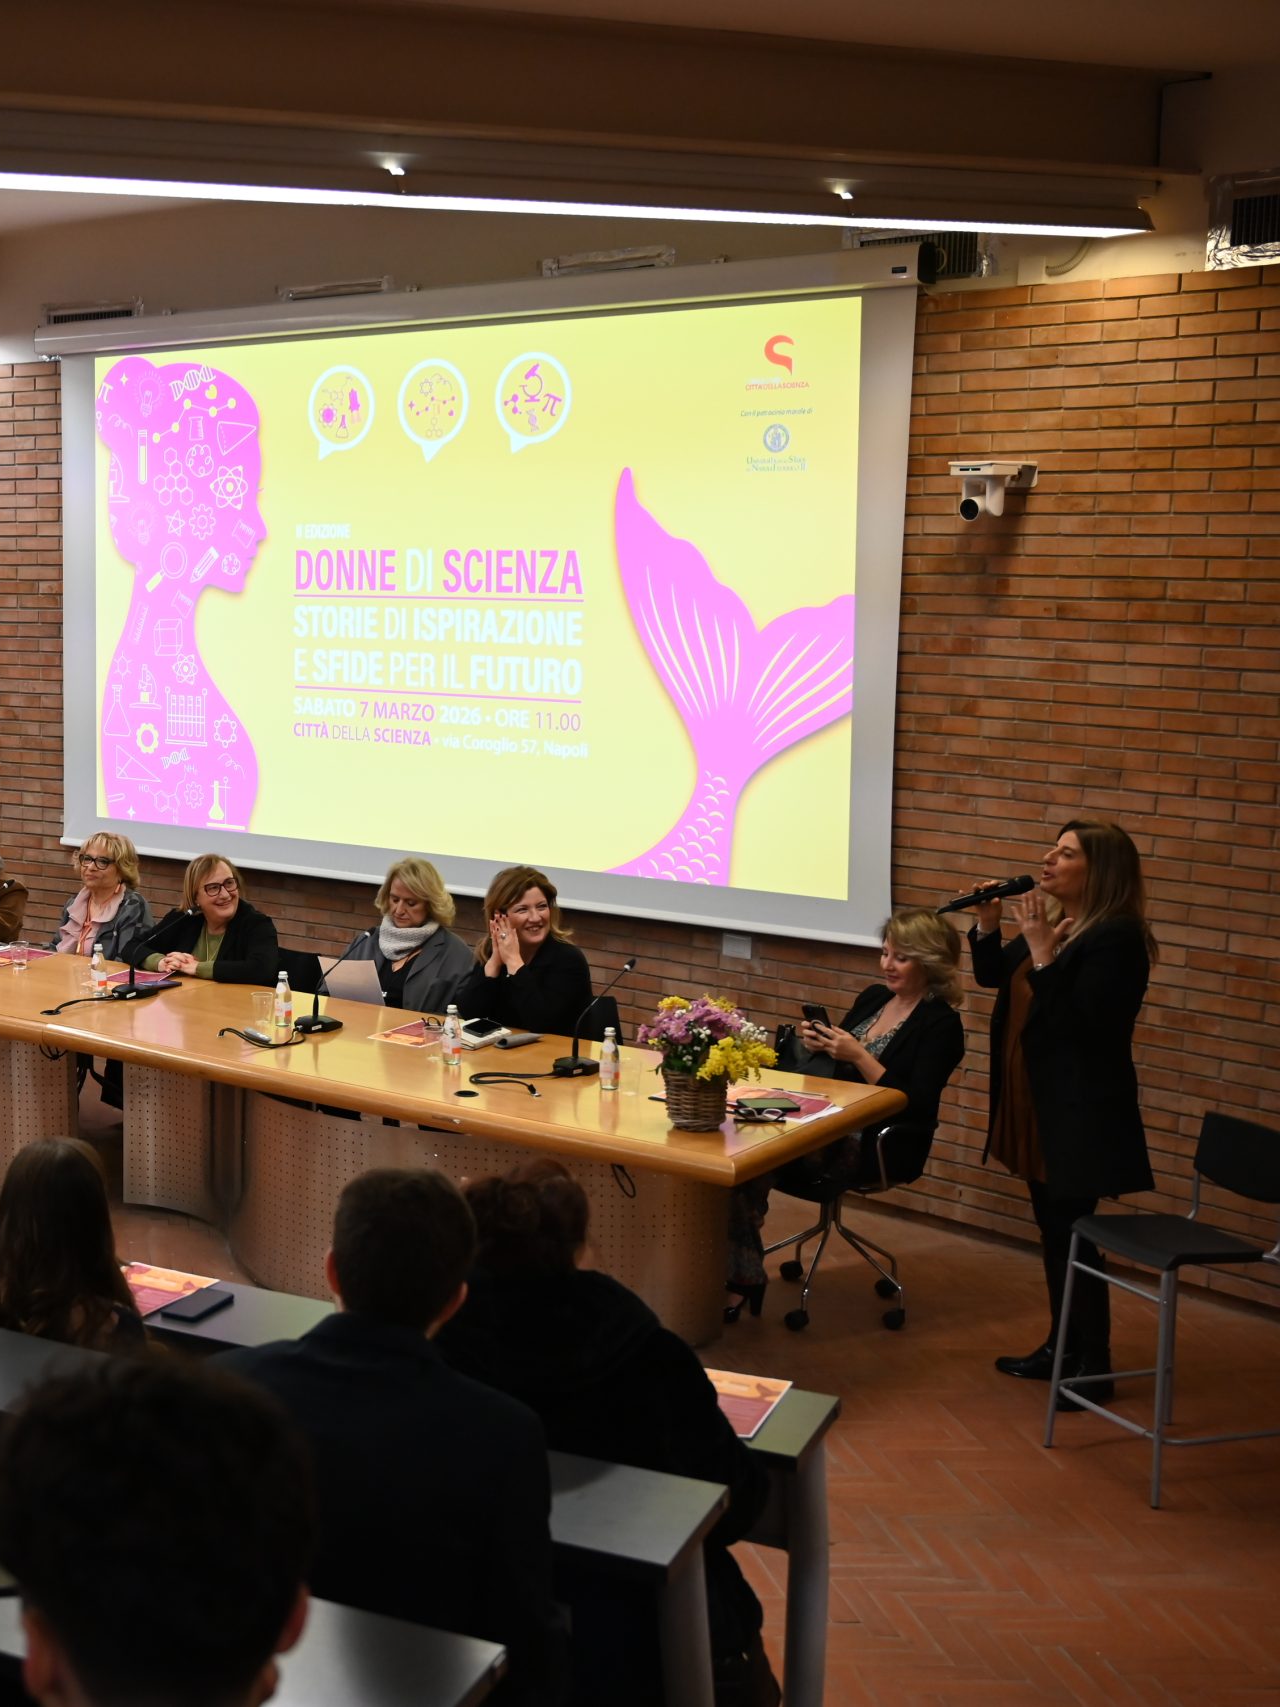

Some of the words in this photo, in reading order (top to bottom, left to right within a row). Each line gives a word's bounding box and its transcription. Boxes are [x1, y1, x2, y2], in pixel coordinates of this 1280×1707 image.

[304, 523, 352, 539] EDIZIONE
[295, 549, 396, 591] DONNE
[405, 548, 432, 592] DI
[443, 549, 583, 594] SCIENZA
[293, 605, 379, 640] STORIE
[384, 607, 407, 640] DI
[413, 606, 583, 646] ISPIRAZIONE
[294, 648, 307, 682] E
[312, 649, 384, 685] SFIDE
[390, 652, 435, 687] PER
[443, 654, 464, 689] IL
[470, 654, 582, 695] FUTURO
[293, 696, 356, 718] SABATO
[360, 701, 369, 718] 7
[373, 702, 435, 722] MARZO
[439, 705, 481, 726] 2026
[494, 708, 531, 730] ORE
[535, 712, 581, 732] 11.00
[293, 721, 329, 739] CITTÀ
[332, 725, 370, 741] DELLA
[374, 727, 432, 746] SCIENZA
[442, 734, 460, 748] via
[463, 735, 518, 755] Coroglio
[543, 741, 589, 759] Napoli
